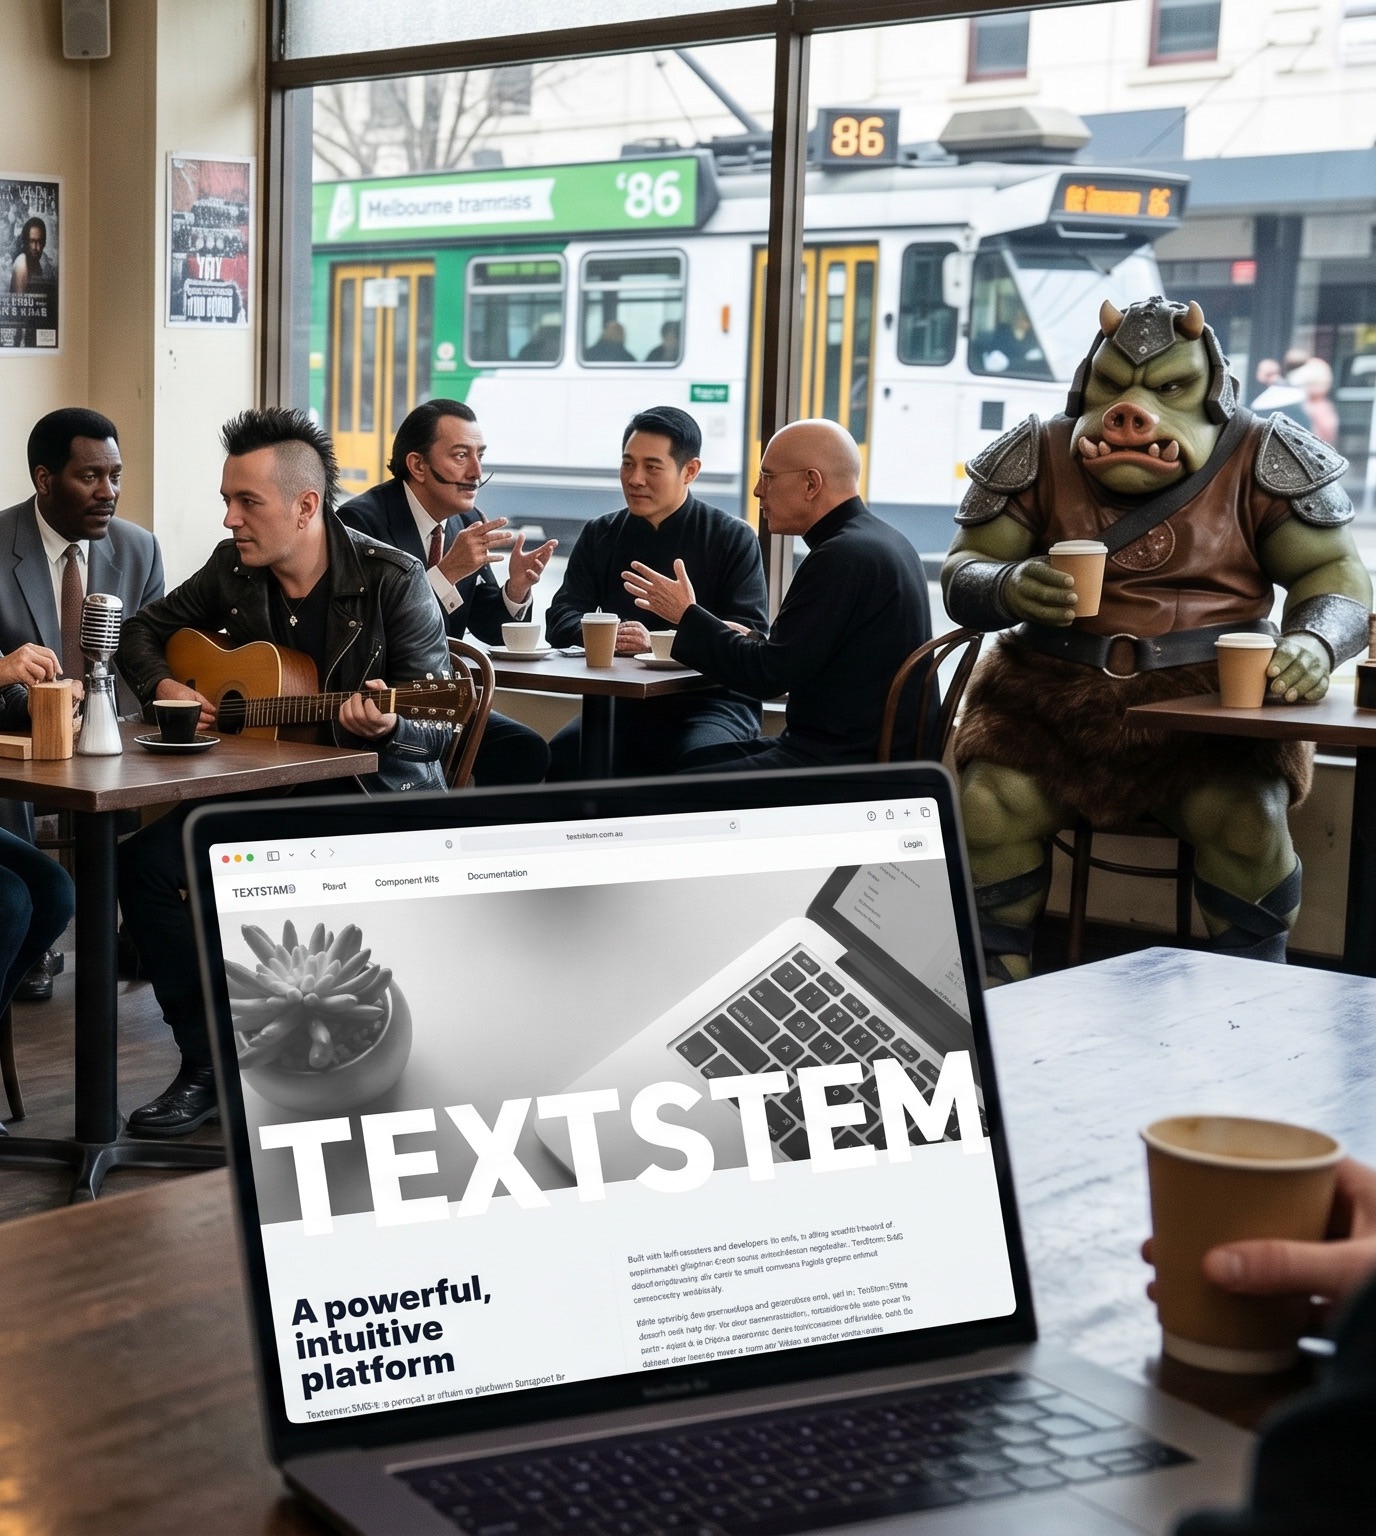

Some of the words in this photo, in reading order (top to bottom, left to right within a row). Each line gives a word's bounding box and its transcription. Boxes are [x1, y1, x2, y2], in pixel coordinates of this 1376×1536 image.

[831, 116, 885, 157] 86
[368, 198, 453, 217] Melbourne
[904, 841, 923, 849] Login
[375, 876, 423, 887] Component
[467, 869, 528, 880] Documentation
[259, 1050, 987, 1236] TEXTSTEM
[713, 1243, 727, 1252] and
[728, 1239, 768, 1250] developers
[292, 1298, 318, 1325] A
[325, 1275, 491, 1327] powerful,
[755, 1301, 769, 1310] and
[295, 1319, 443, 1359] intuitive
[301, 1352, 455, 1400] platform
